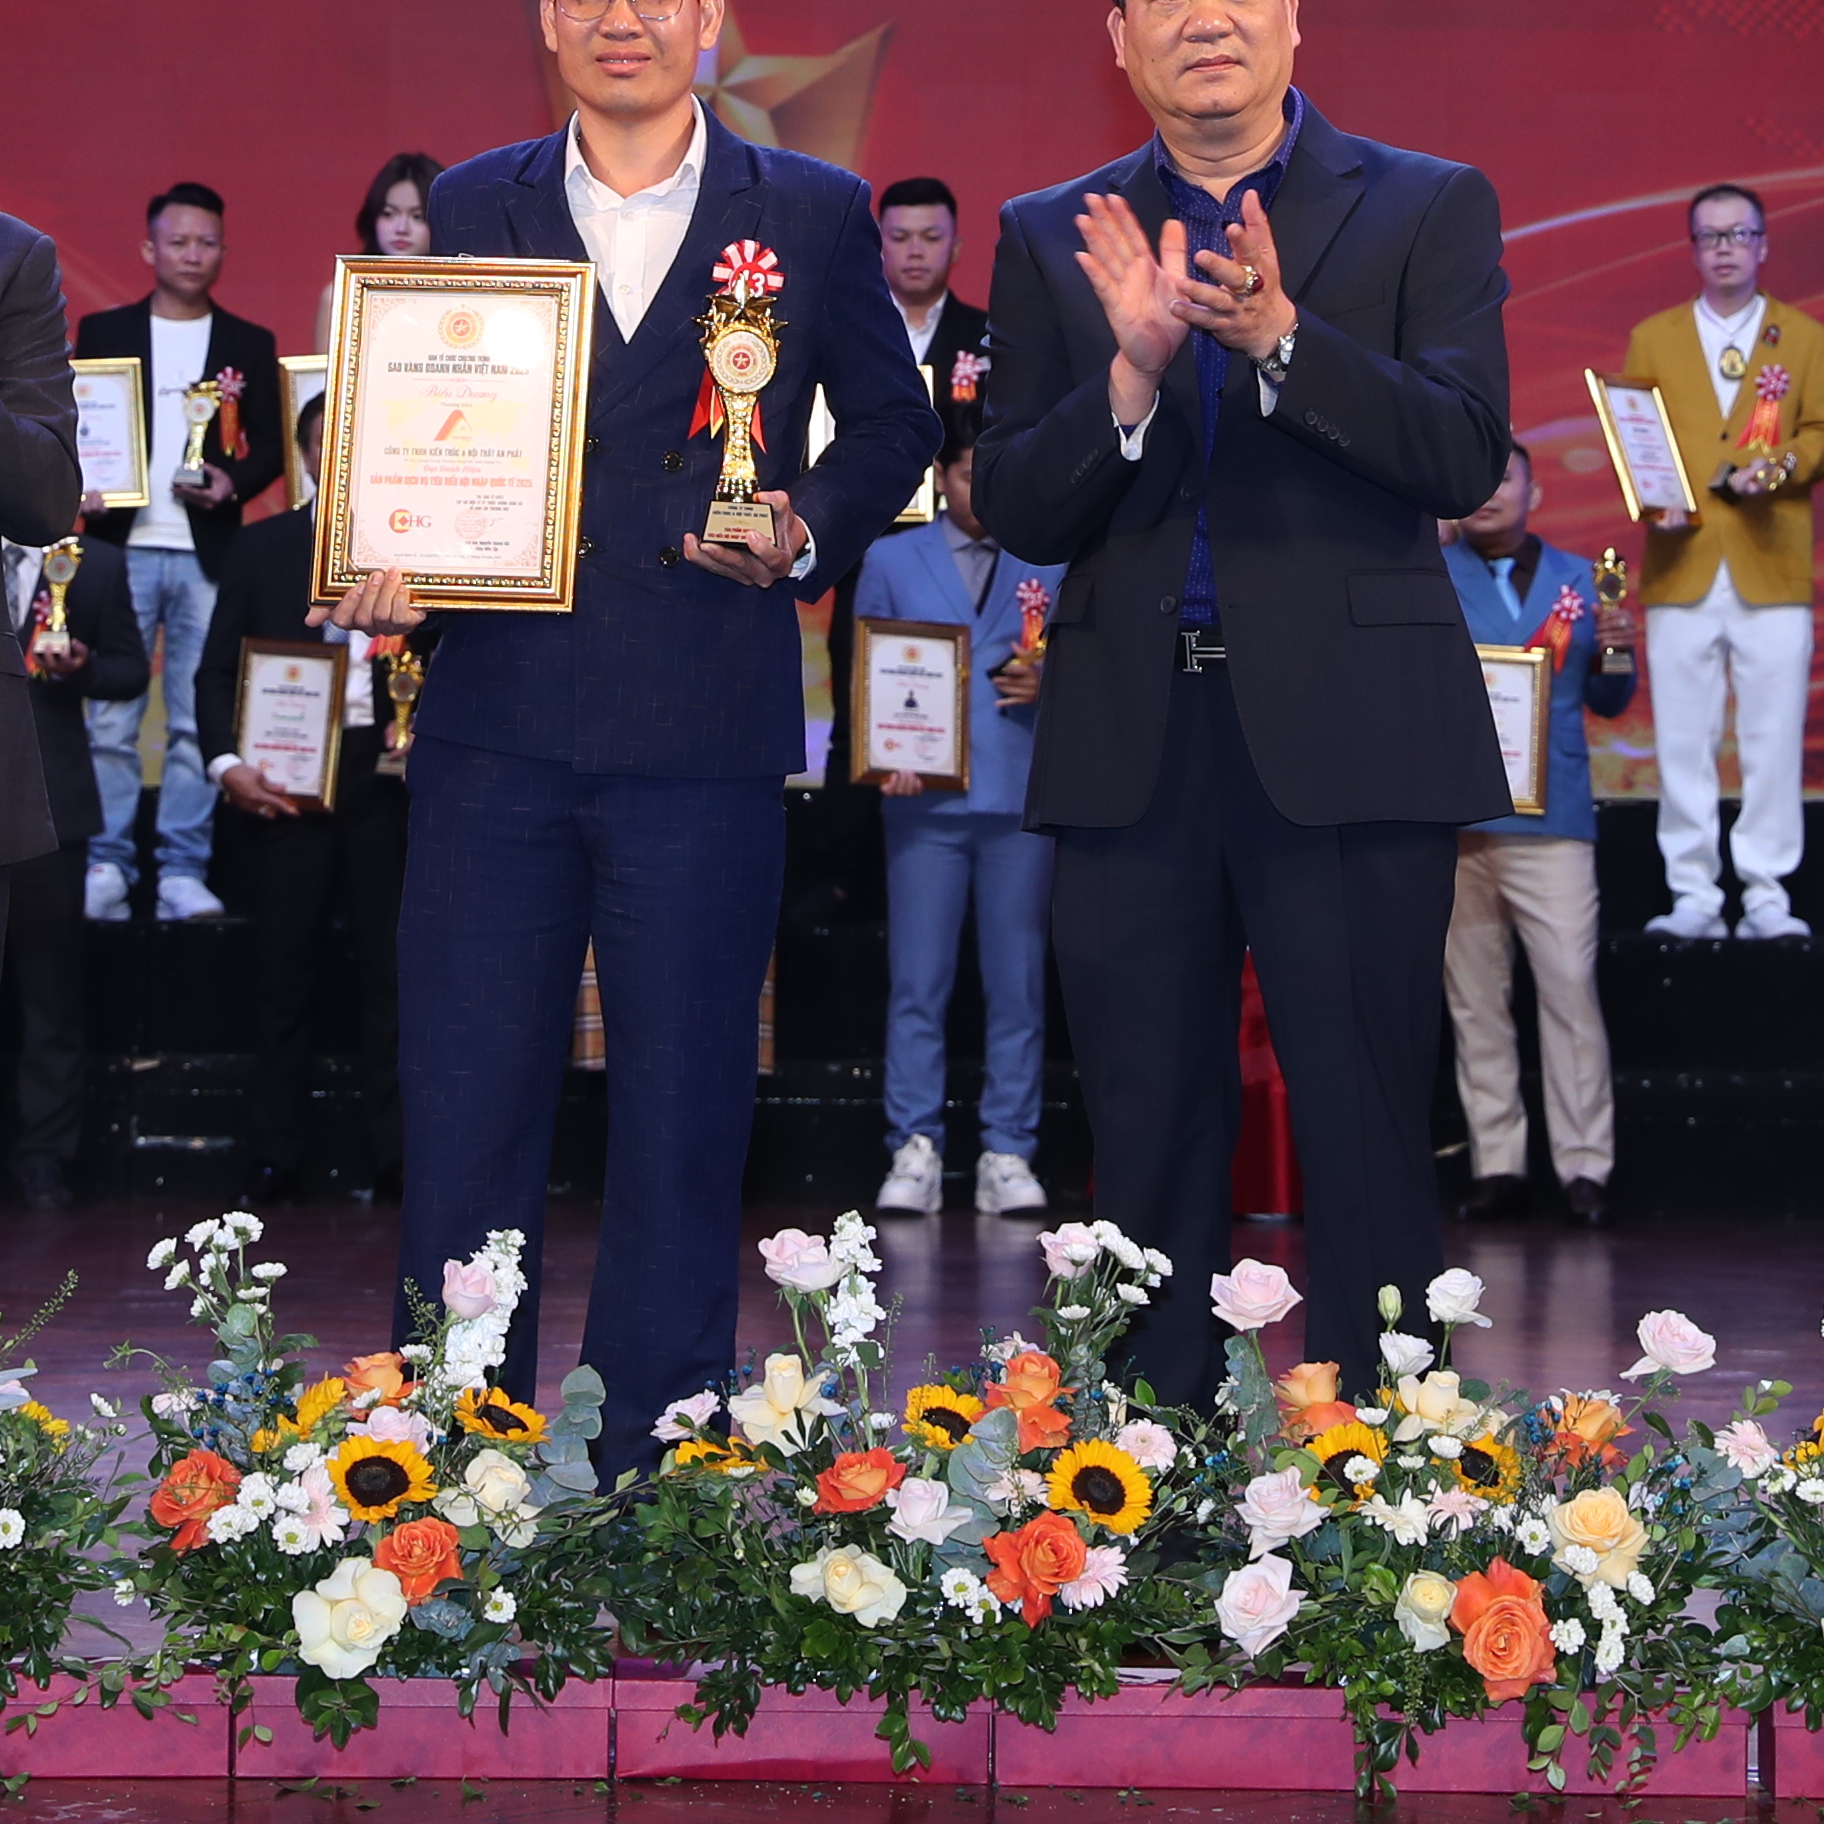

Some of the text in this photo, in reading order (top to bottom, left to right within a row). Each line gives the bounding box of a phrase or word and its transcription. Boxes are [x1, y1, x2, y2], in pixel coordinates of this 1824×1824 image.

[388, 362, 402, 373] SAO
[404, 360, 424, 374] VÀNG
[425, 363, 450, 374] DOANH
[384, 444, 400, 456] CÔNG
[402, 447, 409, 456] TY
[496, 450, 505, 458] AN
